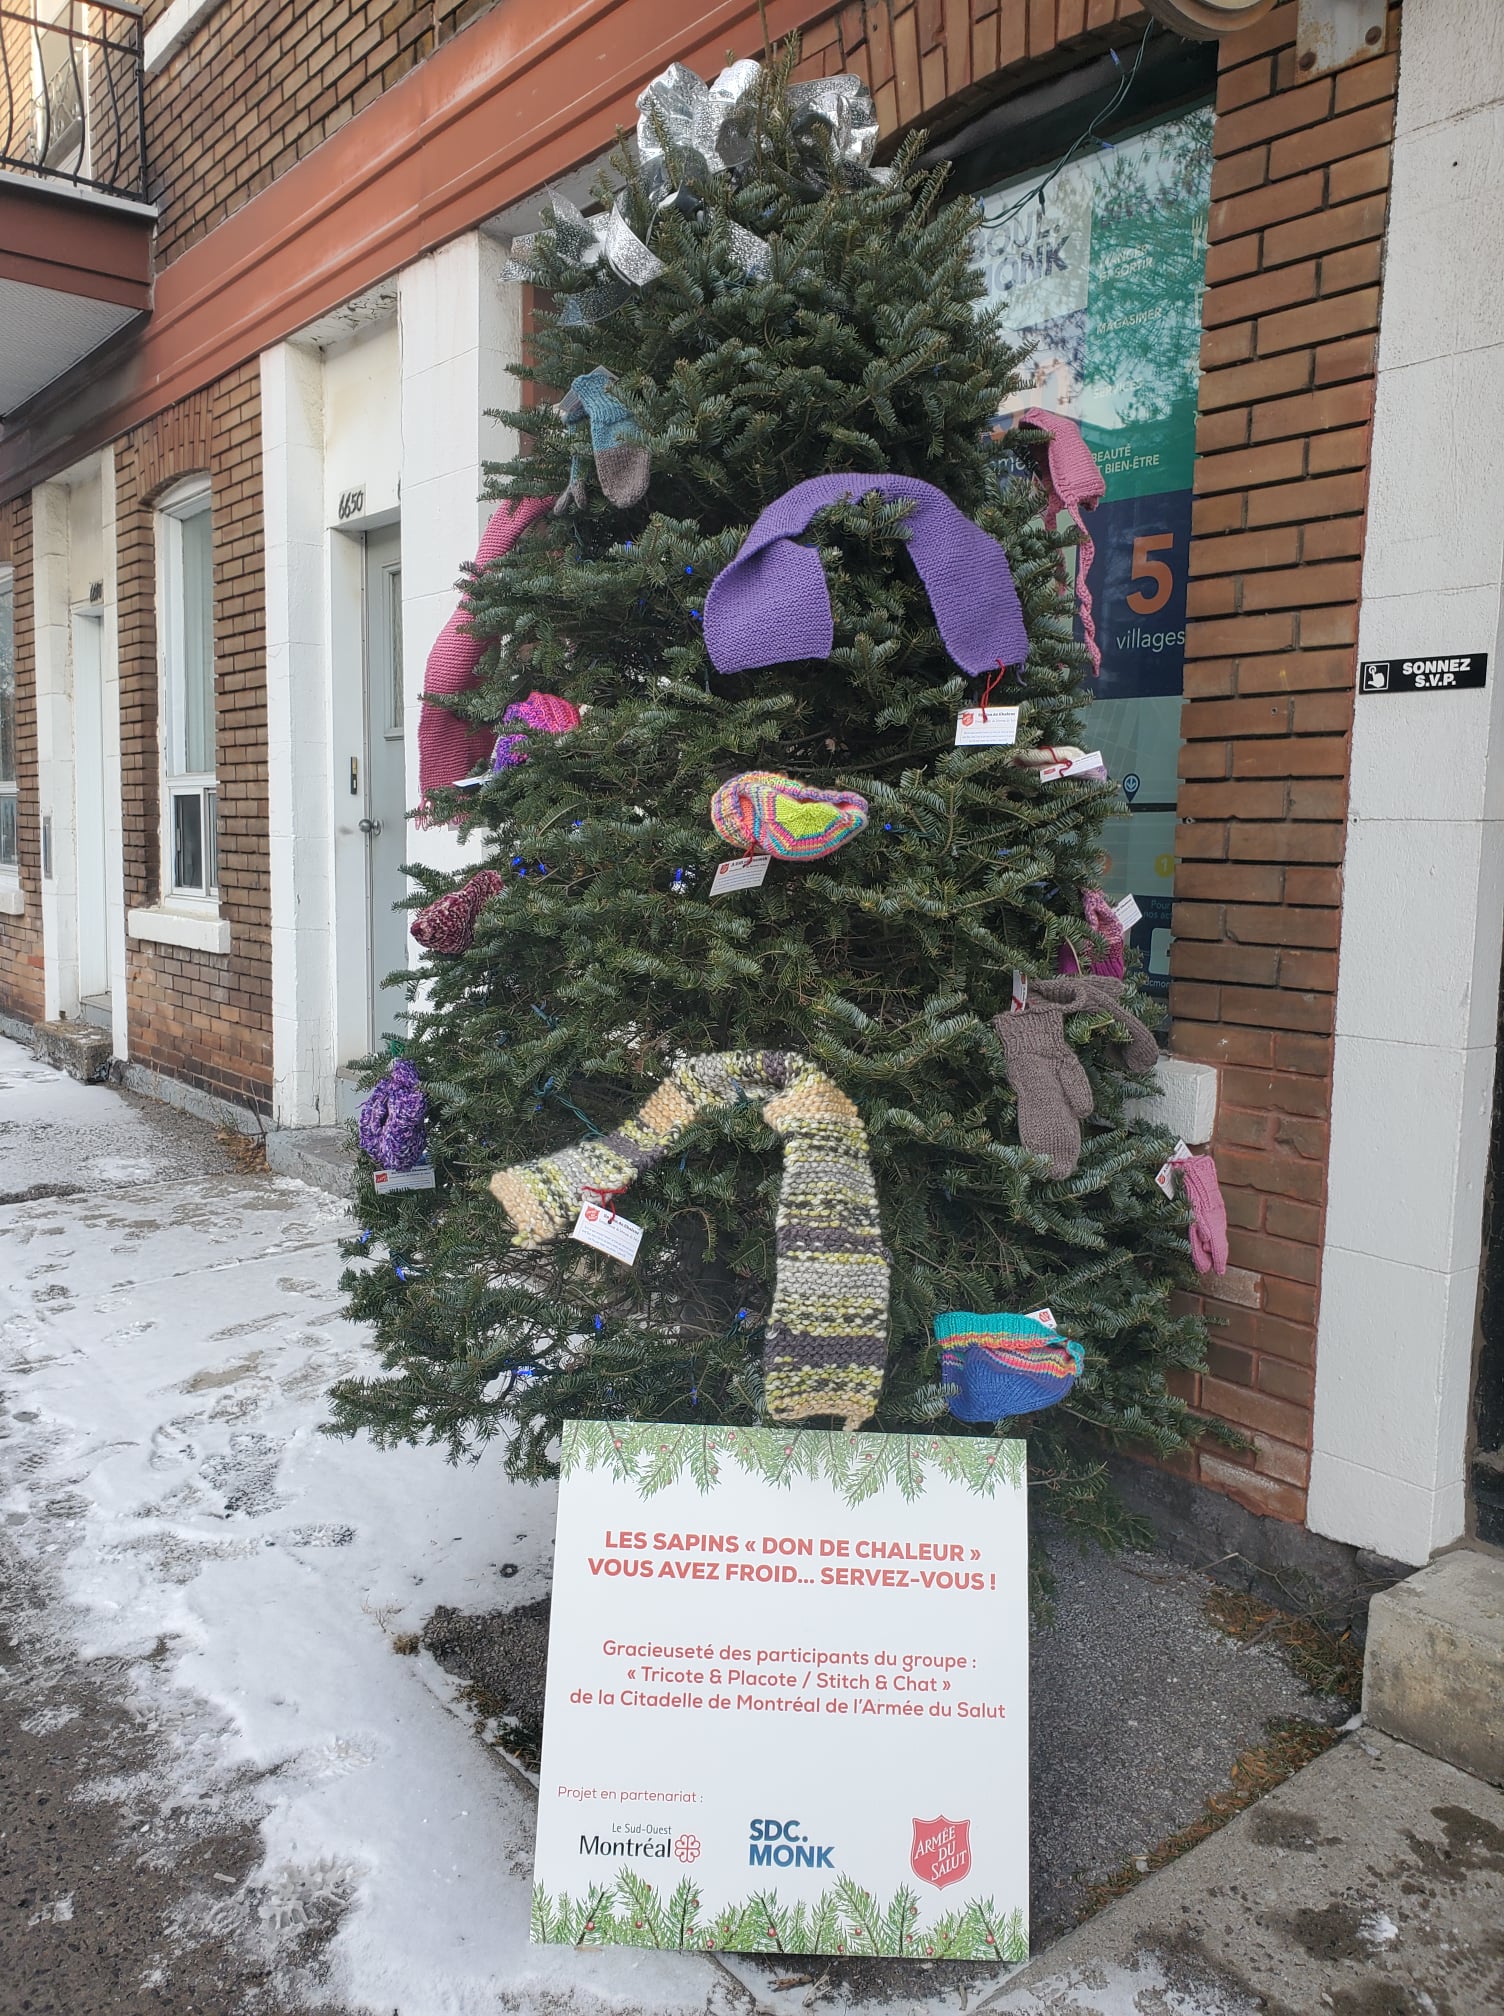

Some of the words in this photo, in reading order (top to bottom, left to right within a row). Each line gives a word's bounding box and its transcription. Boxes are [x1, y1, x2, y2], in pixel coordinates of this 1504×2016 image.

[1091, 443, 1131, 463] BEAUTÉ
[1105, 454, 1160, 474] BIEN-ÊTRE
[338, 490, 364, 520] 6650
[1126, 532, 1174, 615] 5
[1116, 627, 1185, 653] villages
[1402, 658, 1471, 675] SONNEZ
[1414, 673, 1457, 688] S.V.P.
[605, 1530, 647, 1551] LES
[653, 1532, 739, 1554] SAPINS
[762, 1536, 813, 1557] DON
[820, 1539, 850, 1558] DE
[855, 1540, 964, 1563] CHALEUR
[588, 1557, 654, 1579] VOUS
[657, 1561, 720, 1581] AVEZ
[725, 1563, 816, 1585] FROID...
[820, 1566, 985, 1591] SERVEZ-VOUS
[603, 1639, 715, 1661] Gracieuseté
[719, 1645, 752, 1662] des
[756, 1647, 869, 1668] participants
[874, 1650, 898, 1667] du
[902, 1654, 968, 1673] groupe
[641, 1666, 705, 1685] Tricote
[709, 1668, 723, 1685] &
[727, 1669, 797, 1689] Placote
[816, 1671, 870, 1691] Stitch
[875, 1674, 888, 1691] &
[893, 1674, 937, 1693] Chat
[570, 1688, 594, 1705] de
[598, 1689, 615, 1706] la
[620, 1690, 703, 1710] Citadelle
[708, 1693, 732, 1710] de
[736, 1693, 821, 1714] Montréal
[825, 1697, 849, 1715] de
[853, 1698, 925, 1717] l'Armée
[929, 1701, 952, 1718] du
[957, 1702, 1006, 1719] Salut
[557, 1786, 597, 1802] Projet
[600, 1790, 617, 1800] en
[620, 1790, 697, 1803] partenariat
[612, 1822, 622, 1833] Le
[624, 1823, 672, 1835] Sud-Ouest
[749, 1818, 809, 1844] SDC.
[579, 1834, 672, 1858] Montréal
[914, 1826, 956, 1860] ARMÉE
[938, 1841, 956, 1862] DU
[749, 1844, 835, 1869] MONK
[931, 1850, 967, 1881] SALUT
